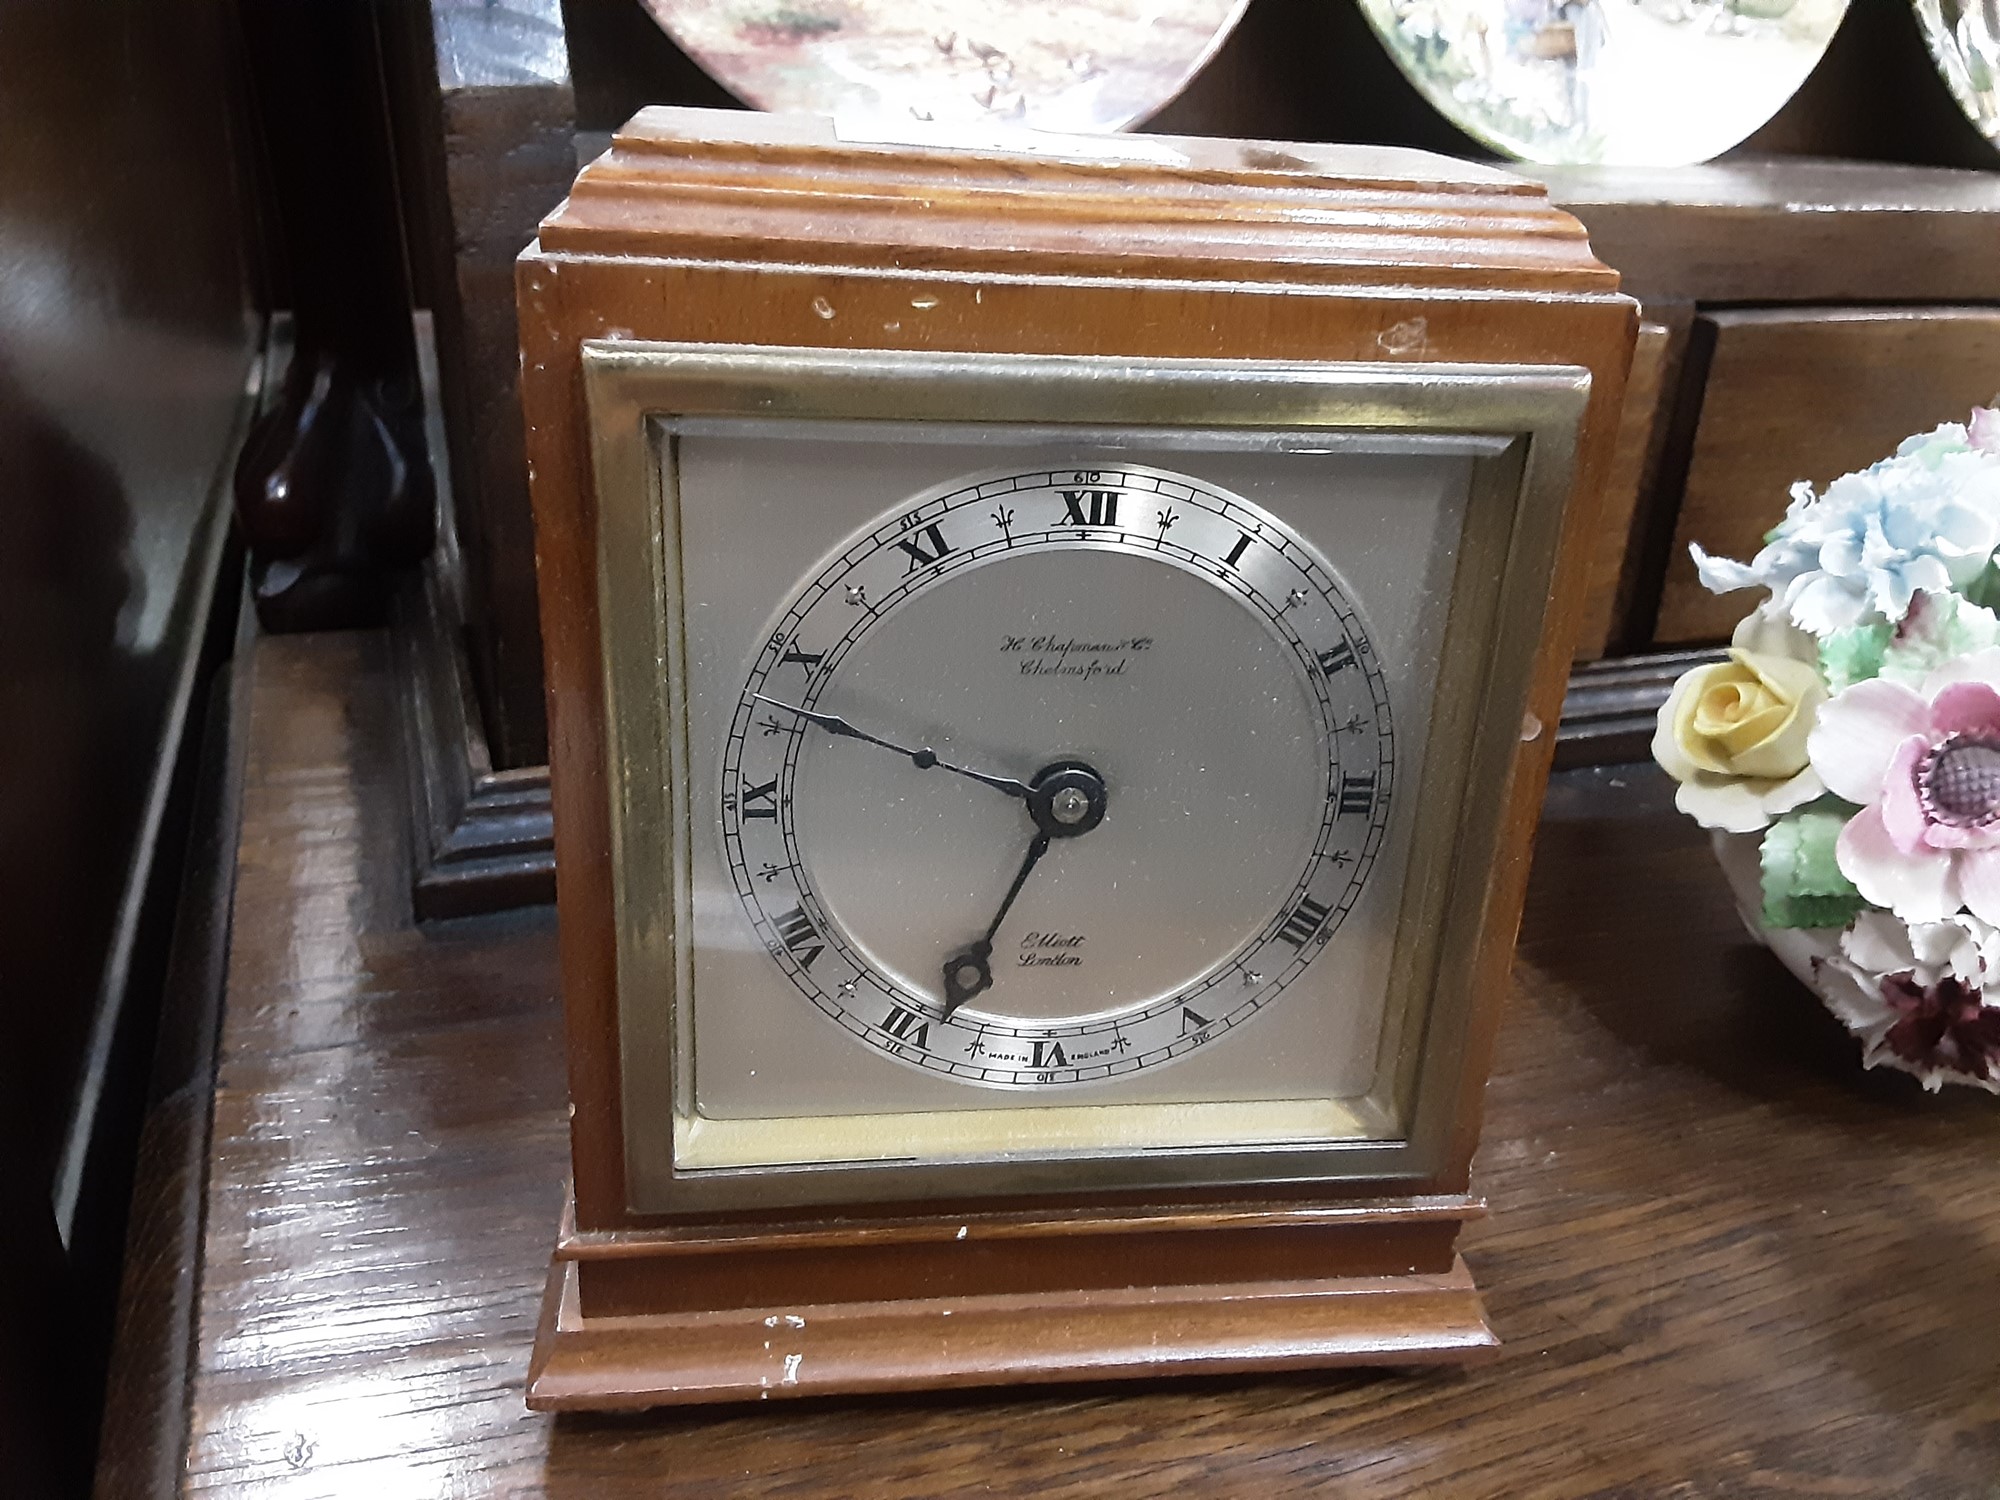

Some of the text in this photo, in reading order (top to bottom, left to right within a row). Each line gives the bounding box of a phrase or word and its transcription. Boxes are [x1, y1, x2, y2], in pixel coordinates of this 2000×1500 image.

[1050, 489, 1128, 528] XII
[887, 518, 960, 579] XI
[1218, 529, 1258, 572] I
[777, 633, 829, 684] X
[1019, 657, 1128, 681] Chelmsford
[1313, 633, 1360, 684] II
[742, 772, 779, 825] IX
[1336, 769, 1378, 822] III
[768, 900, 827, 975] VIII
[1020, 931, 1086, 949] Elliott
[1269, 893, 1335, 957] IIII
[1017, 952, 1083, 967] London
[873, 1001, 932, 1052] VII
[1176, 1006, 1216, 1039] V
[988, 1048, 1111, 1063] MADE IN ENGLAND
[1024, 1040, 1074, 1069] VI
